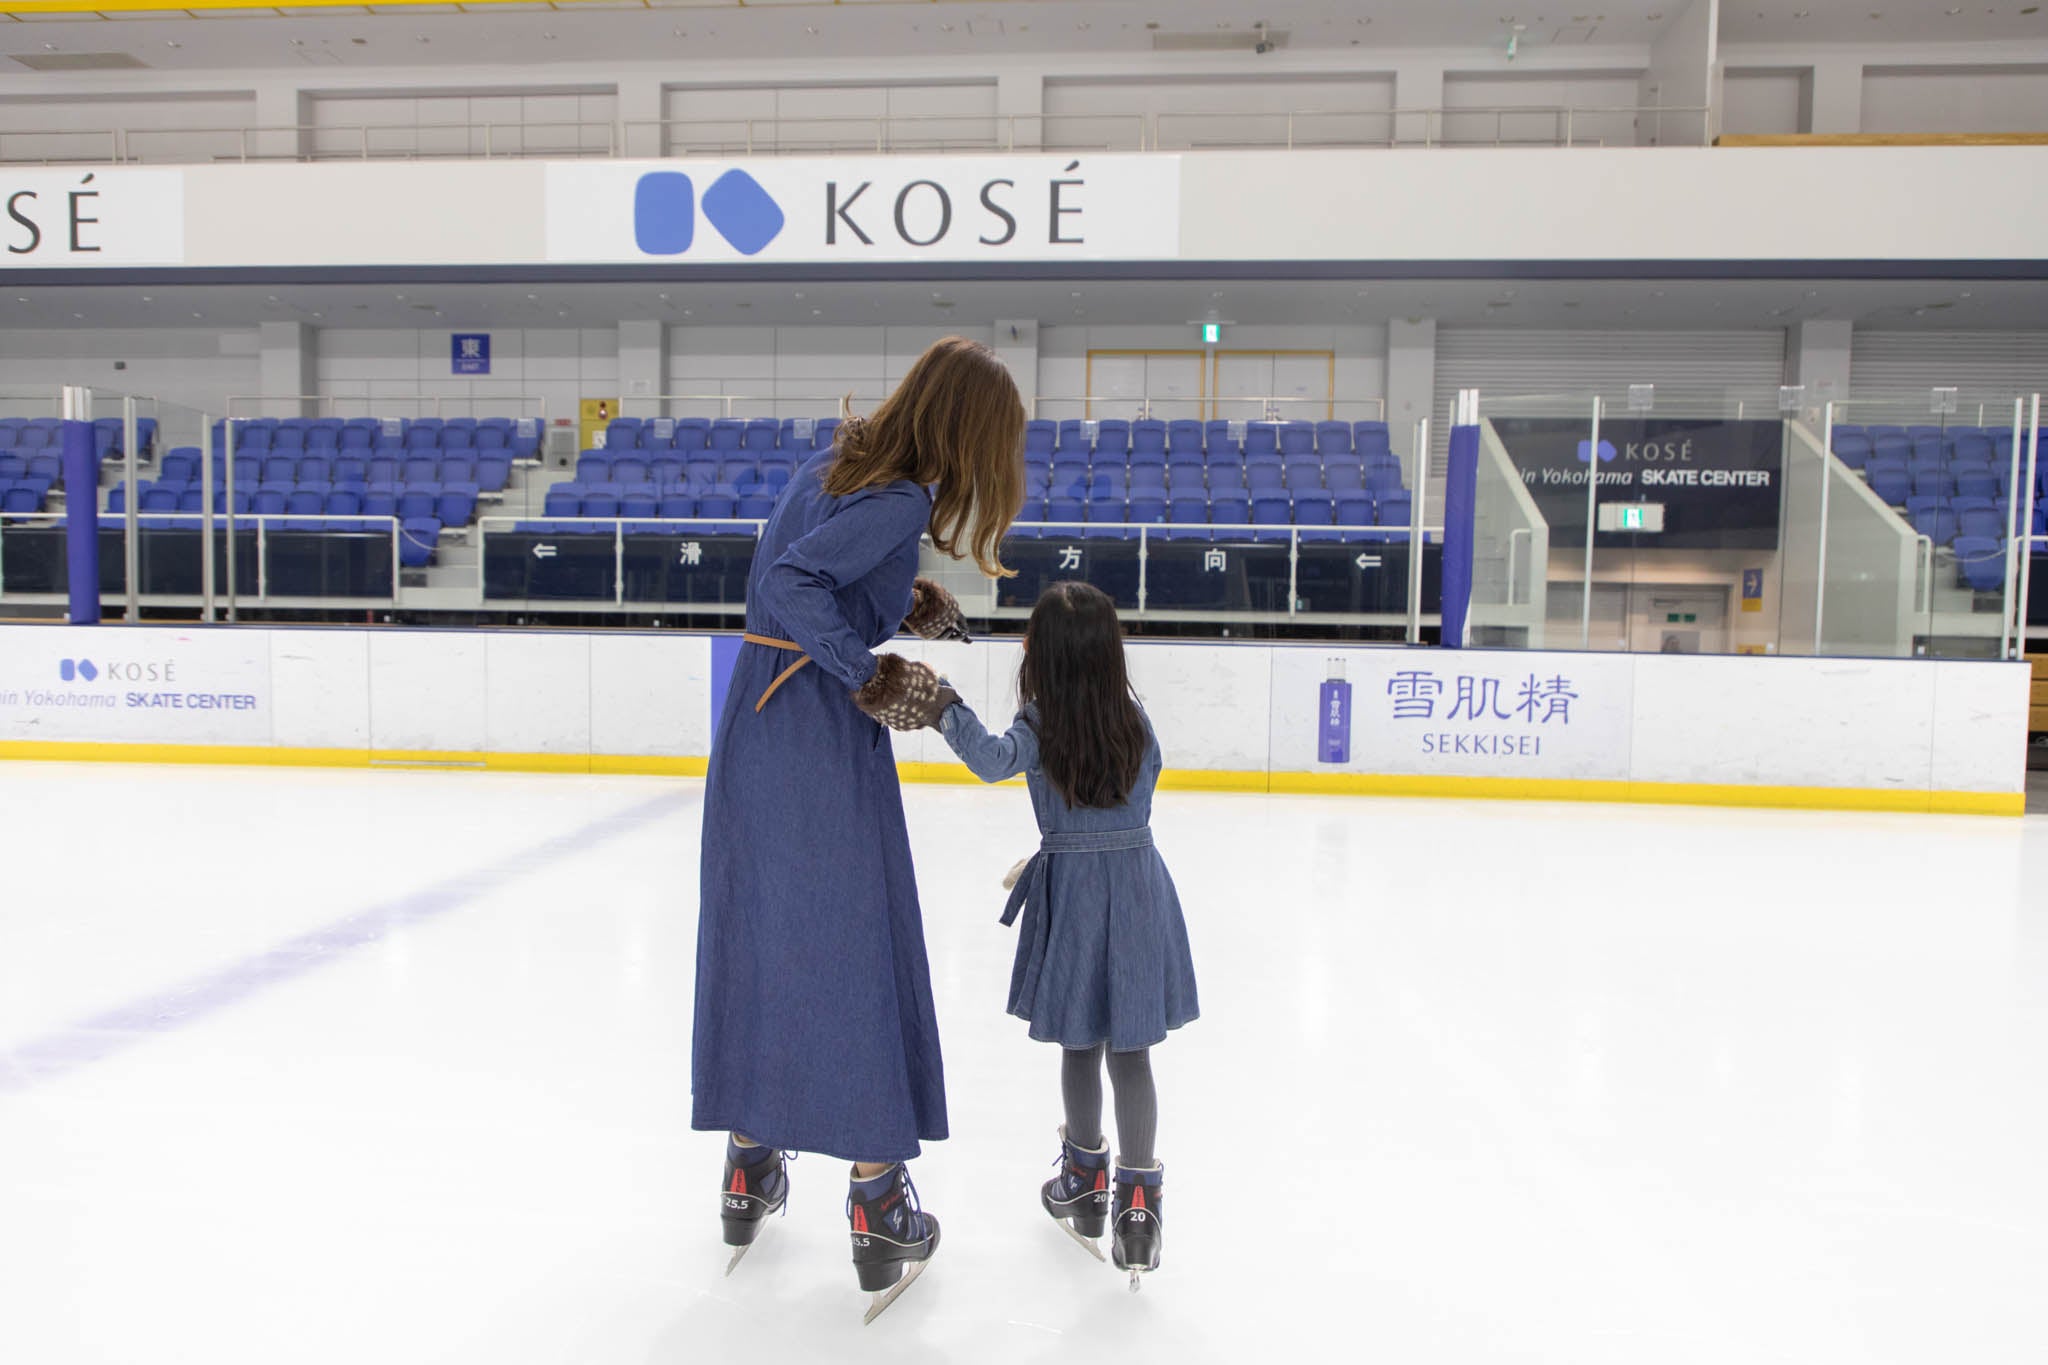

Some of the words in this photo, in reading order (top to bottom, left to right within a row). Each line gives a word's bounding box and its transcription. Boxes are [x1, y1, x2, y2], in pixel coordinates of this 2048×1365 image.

[7, 173, 101, 254] SÉ
[825, 160, 1084, 246] KOSÉ
[1625, 439, 1693, 462] KOSÉ
[1641, 469, 1699, 486] SKATE
[1700, 470, 1770, 486] CENTER
[1059, 546, 1083, 570] 方
[1204, 548, 1227, 572] 向
[107, 659, 176, 682] KOSÉ
[24, 690, 117, 708] Yokohama
[125, 692, 183, 708] SKATE
[186, 694, 257, 710] CENTER
[1387, 671, 1579, 725] 雪肌精
[1422, 733, 1541, 756] SEKKISEI
[725, 1197, 749, 1210] 25.5
[1093, 1193, 1107, 1203] 20
[1130, 1211, 1146, 1222] 20
